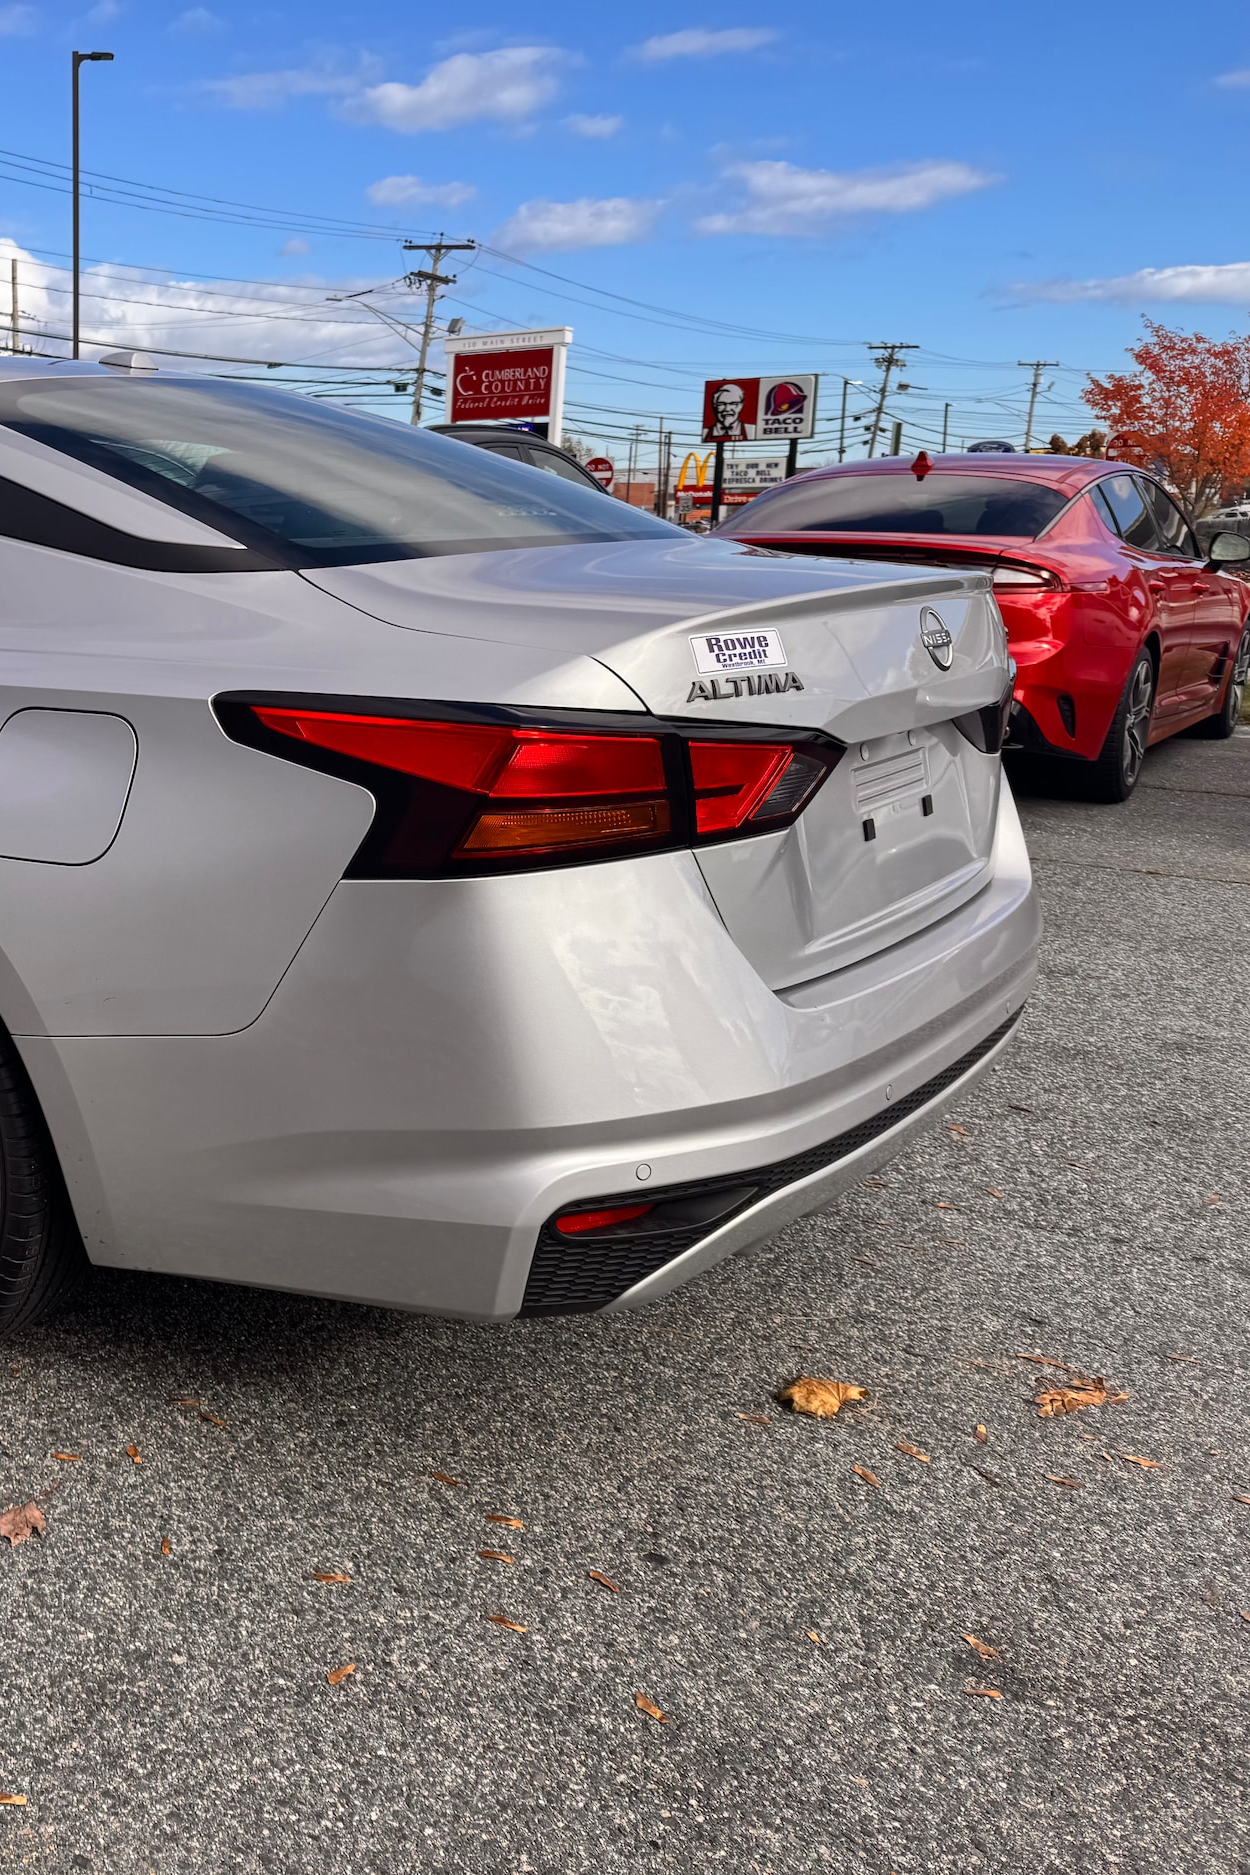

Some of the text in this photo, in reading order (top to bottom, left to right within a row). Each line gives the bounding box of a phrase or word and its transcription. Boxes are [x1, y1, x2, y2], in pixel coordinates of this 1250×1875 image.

[510, 335, 544, 344] STREET
[482, 366, 548, 381] CUMBERLAND
[481, 379, 547, 393] COUNTY
[456, 395, 546, 408] Federal Credit Union
[763, 417, 803, 426] TACO
[763, 426, 802, 434] BELL
[745, 462, 759, 470] OUR
[705, 635, 769, 653] Rowe
[715, 648, 769, 664] Credit
[686, 672, 805, 703] ALTIMA
